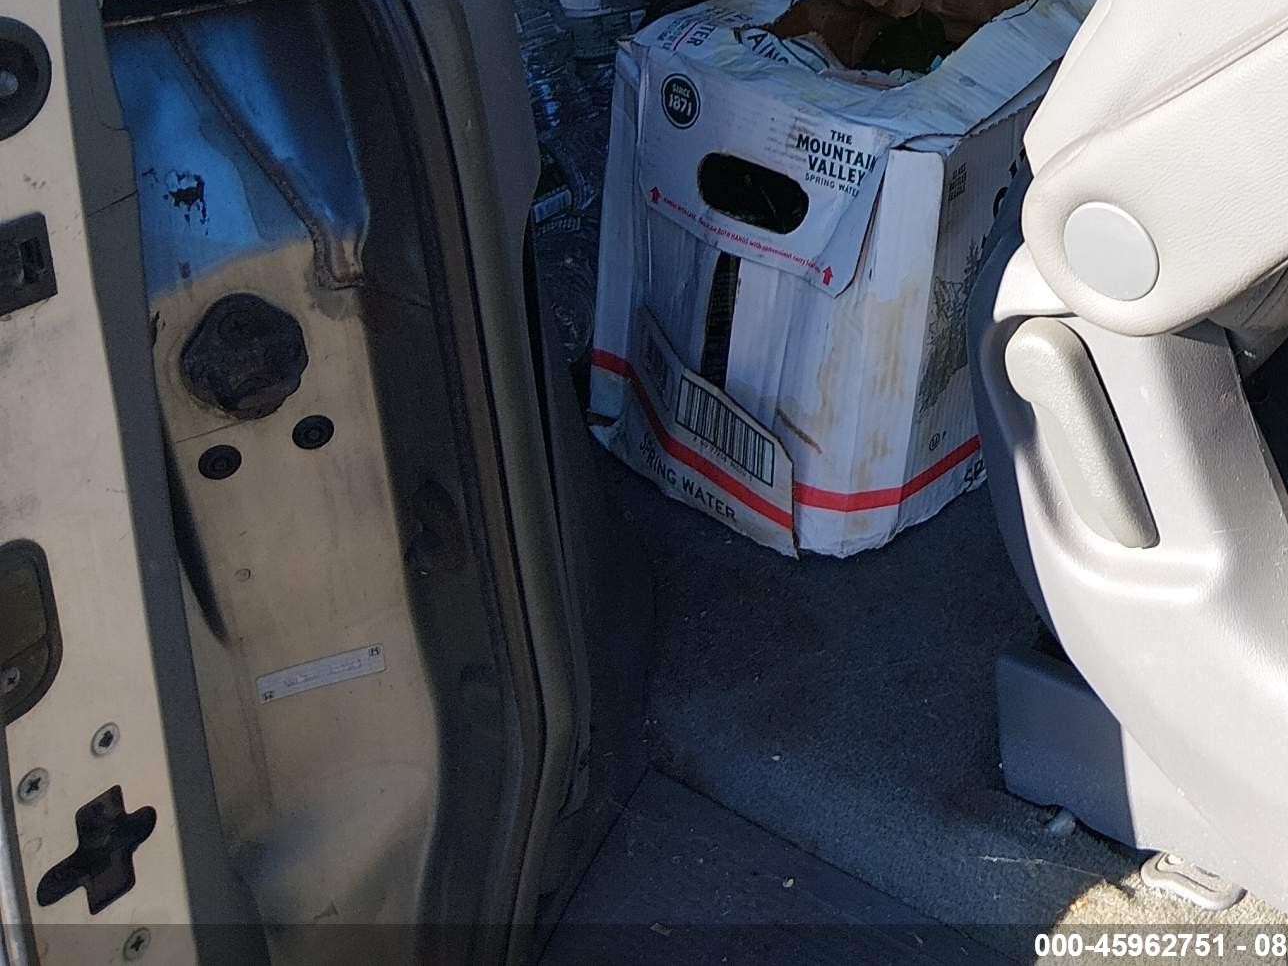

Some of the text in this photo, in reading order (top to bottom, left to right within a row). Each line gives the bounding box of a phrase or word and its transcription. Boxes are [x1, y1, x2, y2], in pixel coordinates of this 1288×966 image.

[671, 82, 692, 98] SINCE
[668, 93, 693, 117] 1871
[830, 129, 853, 145] THE
[805, 172, 836, 189] SPRING
[808, 154, 867, 187] VALLEY
[638, 433, 679, 486] SPRING
[681, 476, 739, 521] WATER
